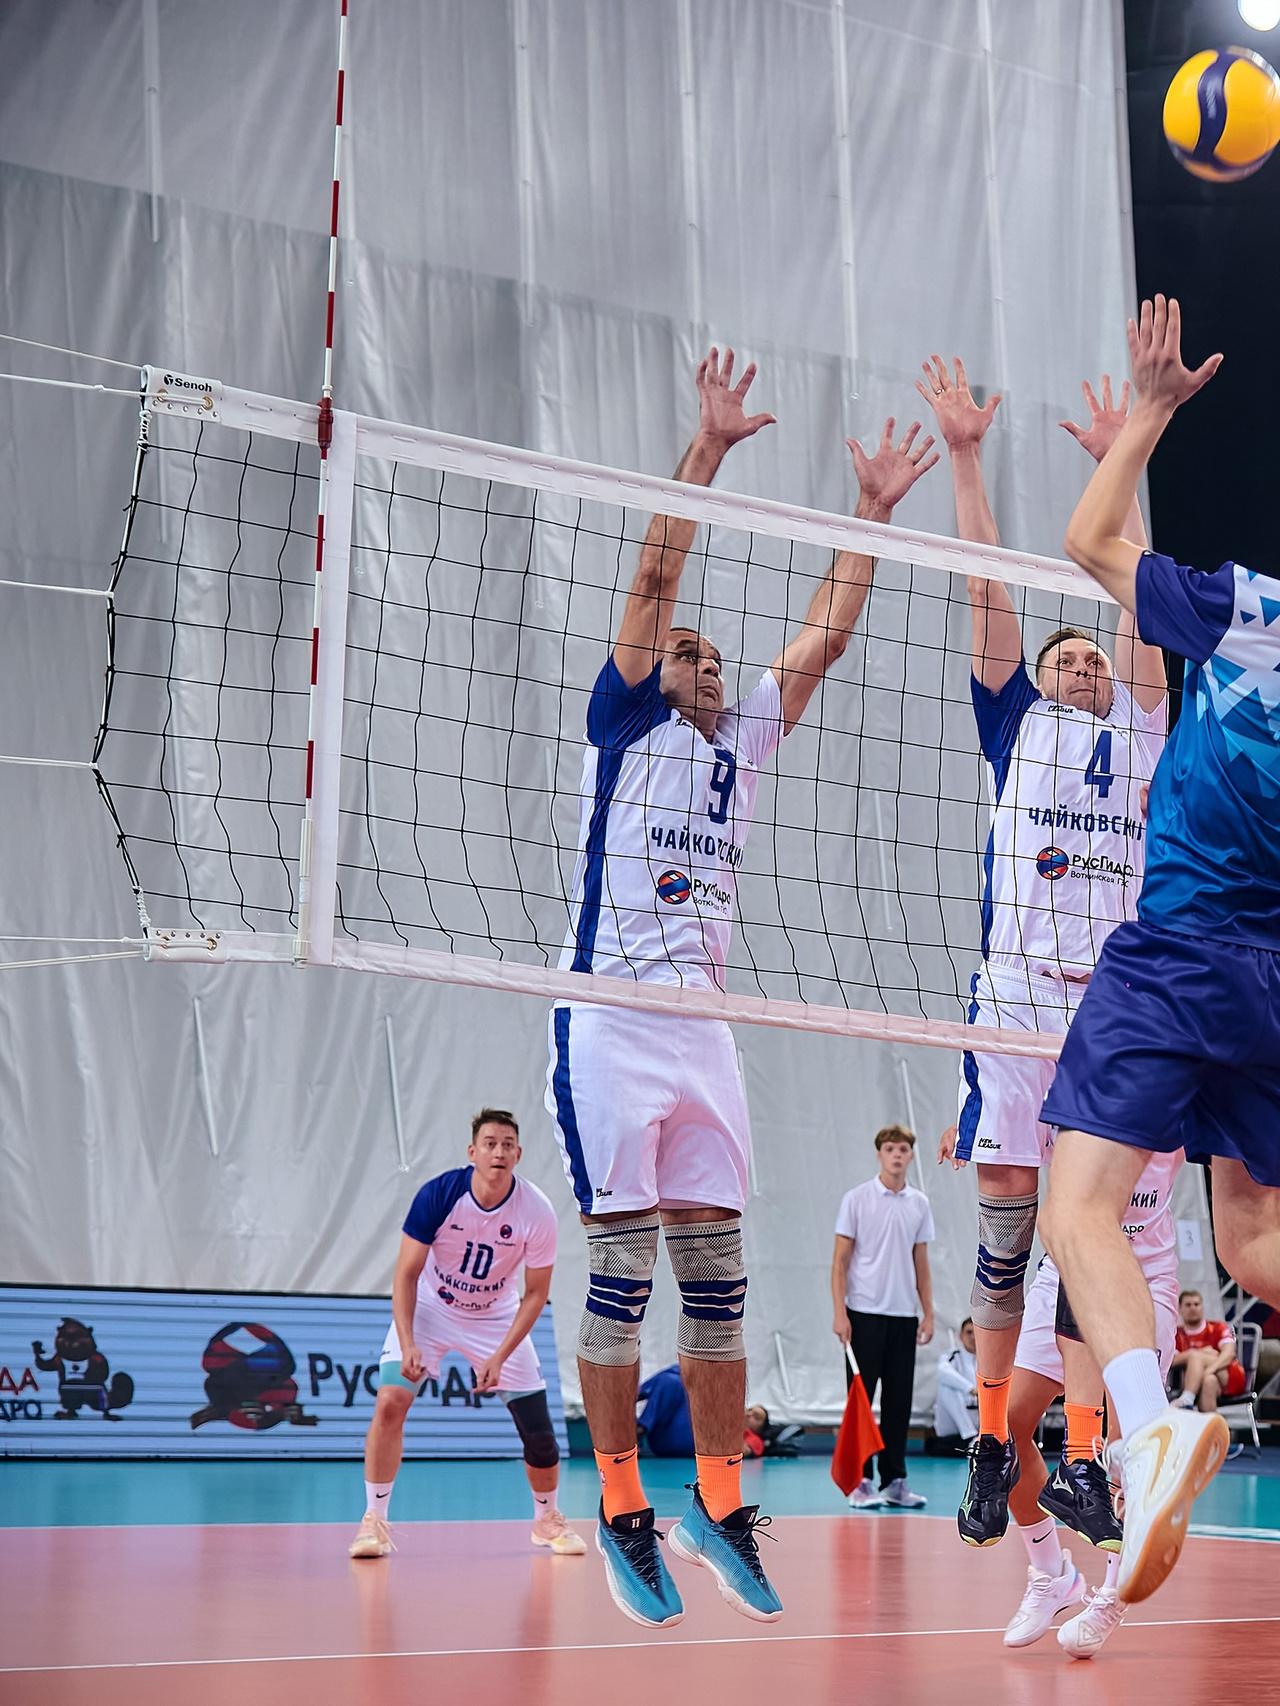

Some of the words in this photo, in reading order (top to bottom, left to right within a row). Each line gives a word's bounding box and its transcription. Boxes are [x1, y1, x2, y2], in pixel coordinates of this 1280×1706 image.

[174, 377, 213, 393] Senoh
[1084, 729, 1115, 799] 4
[707, 747, 736, 825] 9
[1185, 1229, 1195, 1248] 3
[459, 1241, 494, 1281] 10
[631, 1517, 641, 1529] 11
